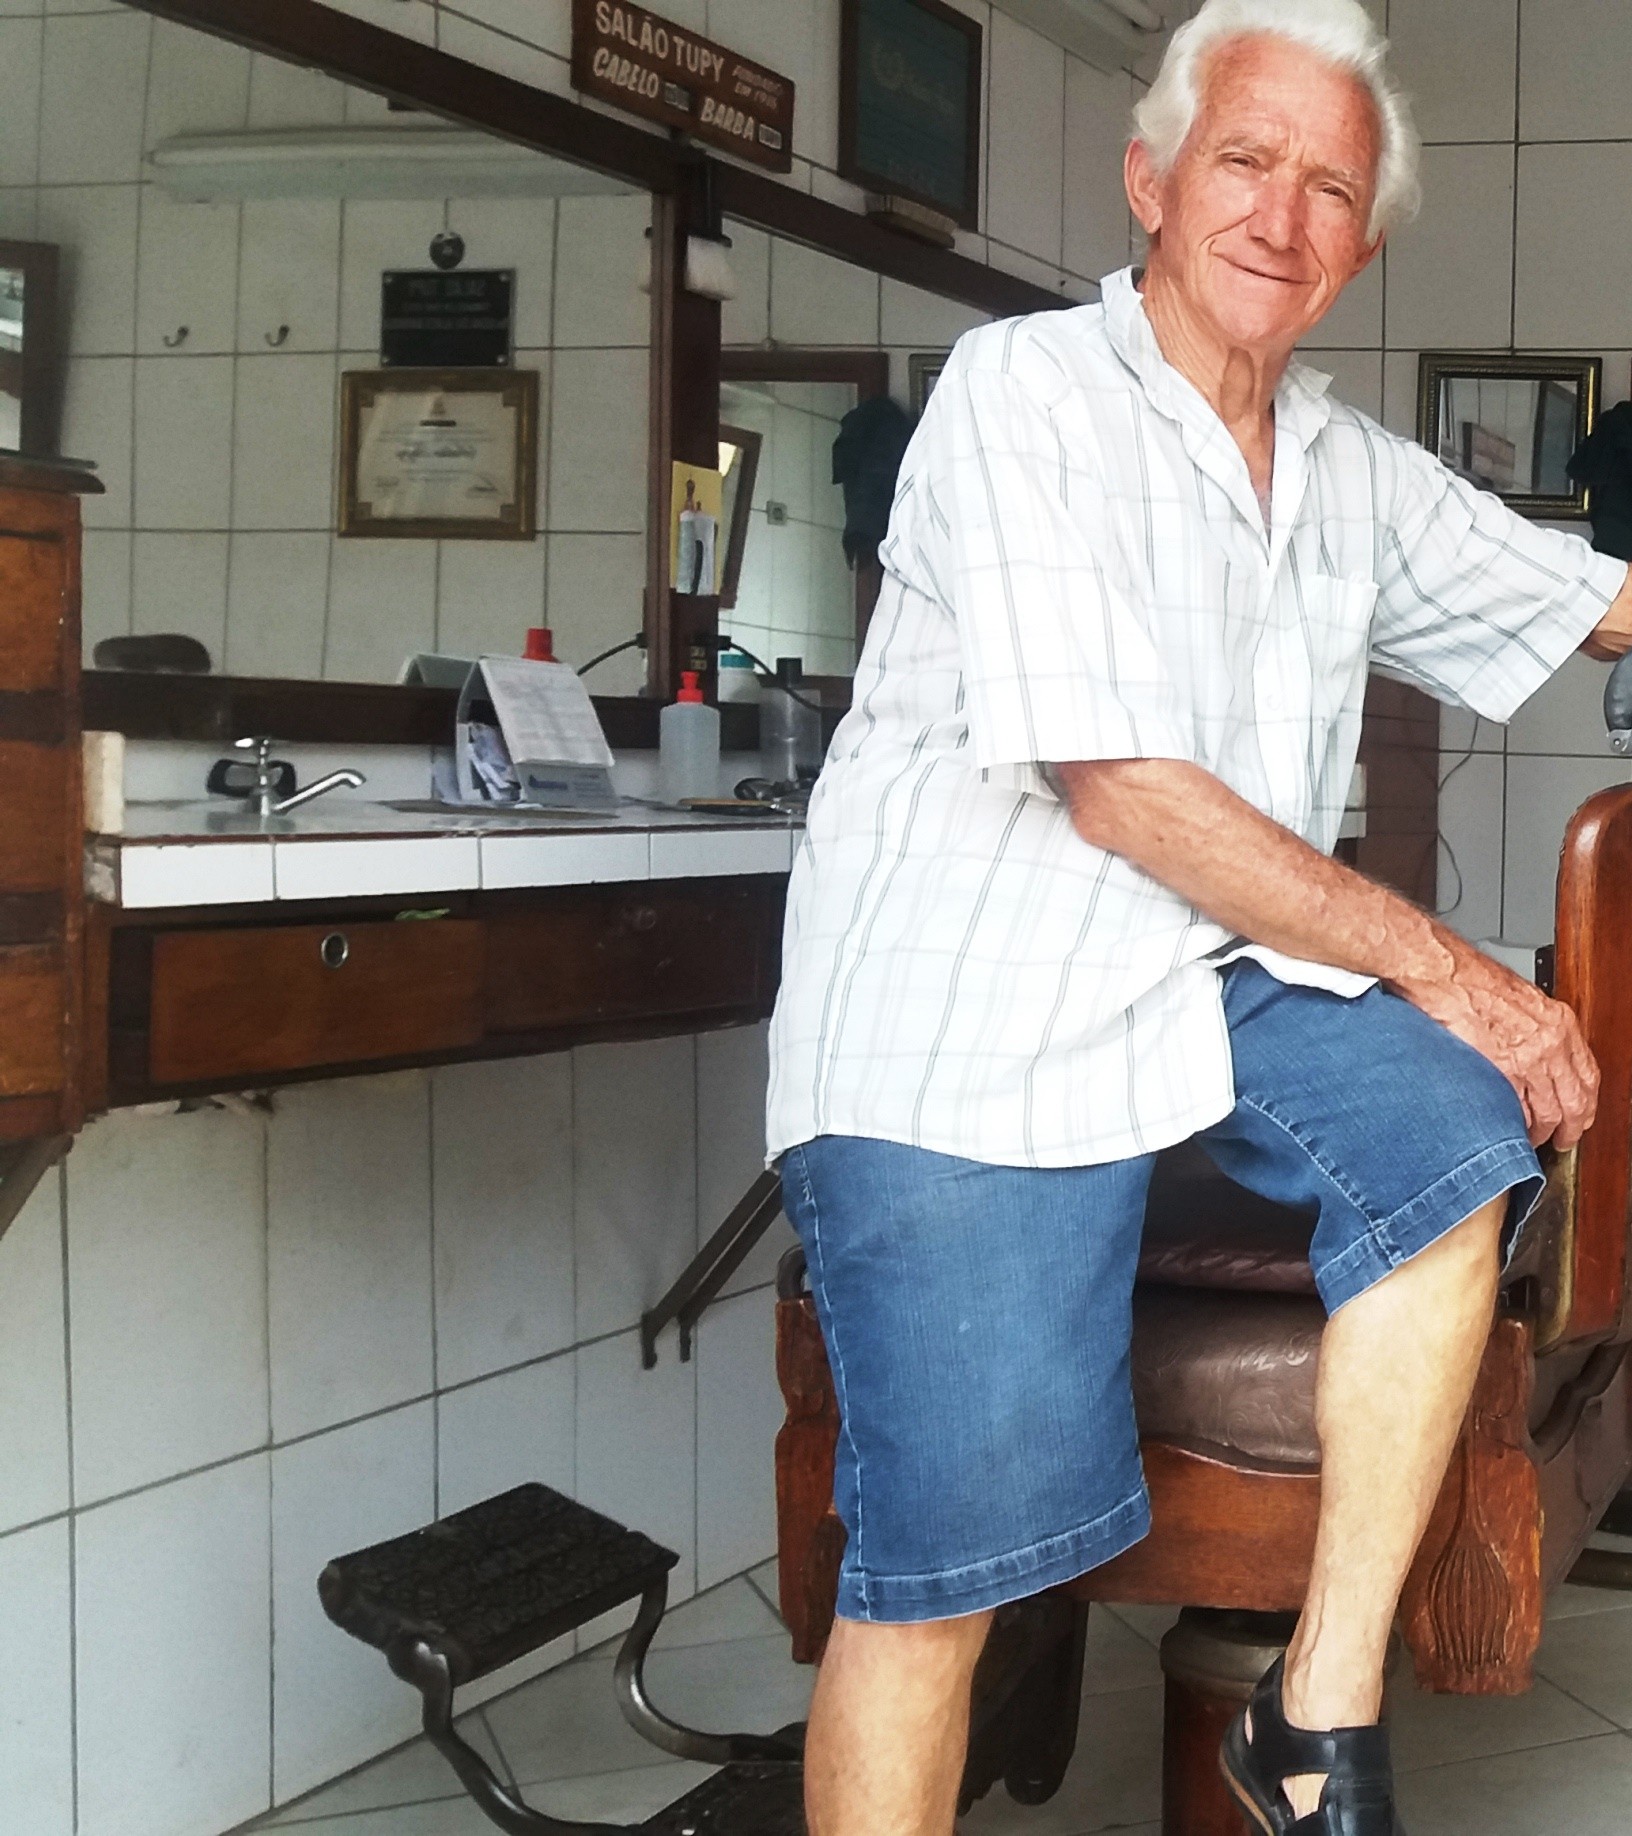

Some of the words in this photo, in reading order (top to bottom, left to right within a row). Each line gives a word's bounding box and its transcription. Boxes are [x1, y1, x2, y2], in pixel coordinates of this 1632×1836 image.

[595, 1, 669, 59] SALÃO
[672, 36, 725, 83] TUPY
[592, 47, 659, 99] CABELO
[701, 97, 756, 142] BARBA
